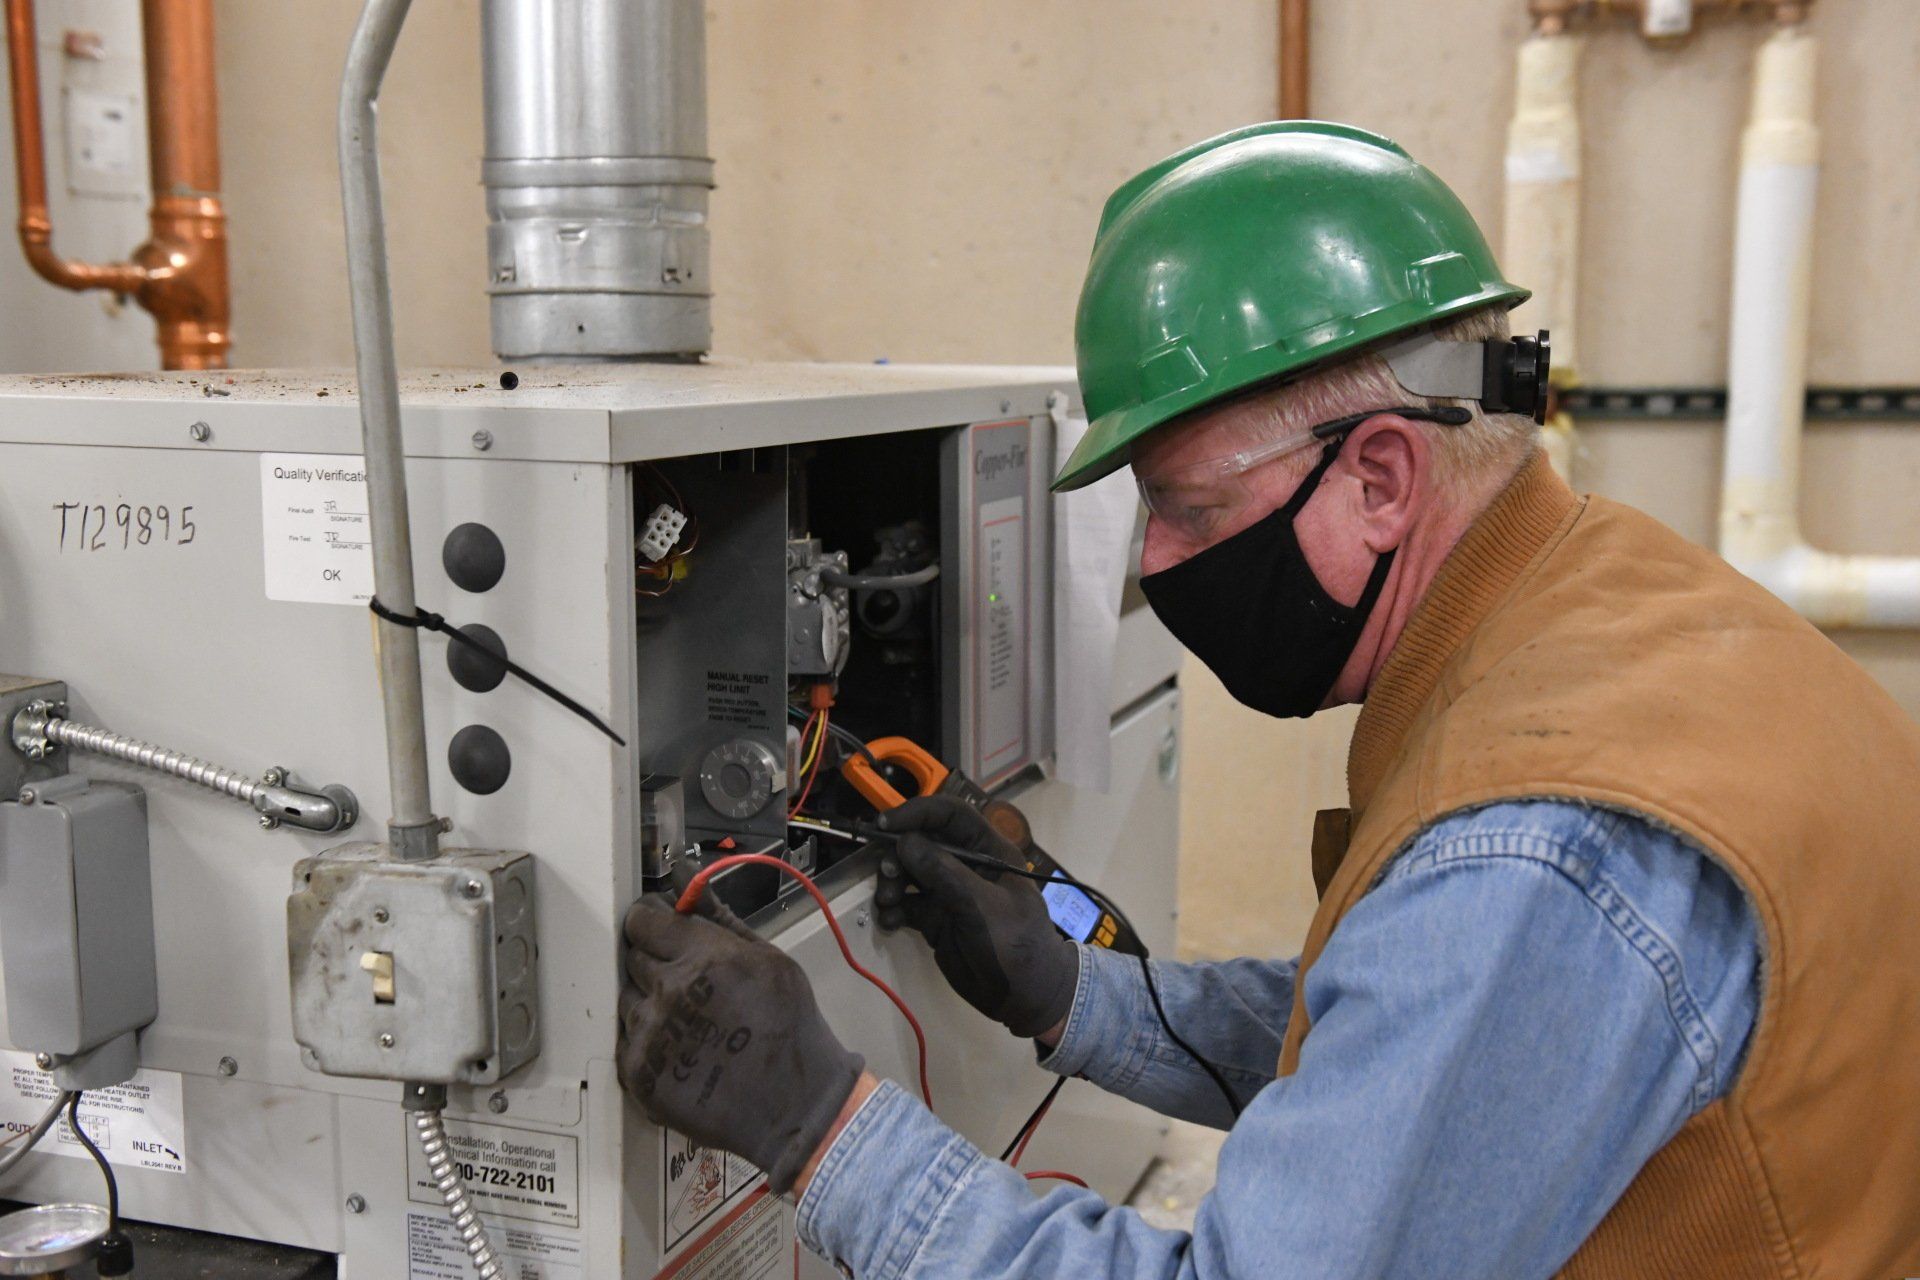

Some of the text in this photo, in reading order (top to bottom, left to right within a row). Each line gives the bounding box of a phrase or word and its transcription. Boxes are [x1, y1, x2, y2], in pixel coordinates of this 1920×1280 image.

[274, 467, 368, 482] Quality Verificatio
[53, 502, 196, 555] T129895
[323, 569, 341, 581] OK
[707, 671, 769, 684] MANUAL RESET
[707, 682, 751, 695] HIGH LIMIT
[13, 1068, 35, 1077] PROPER
[36, 1085, 59, 1094] FOLLOW
[104, 1088, 127, 1097] HEATER
[128, 1091, 151, 1100] OUTLET
[33, 1092, 58, 1101] OPERAT
[132, 1140, 163, 1153] INLET
[447, 1136, 555, 1160] nstallation, Operational
[452, 1148, 556, 1172] hnical Information call
[455, 1162, 555, 1194] 00-722-2101
[544, 1200, 567, 1210] NUMBERS
